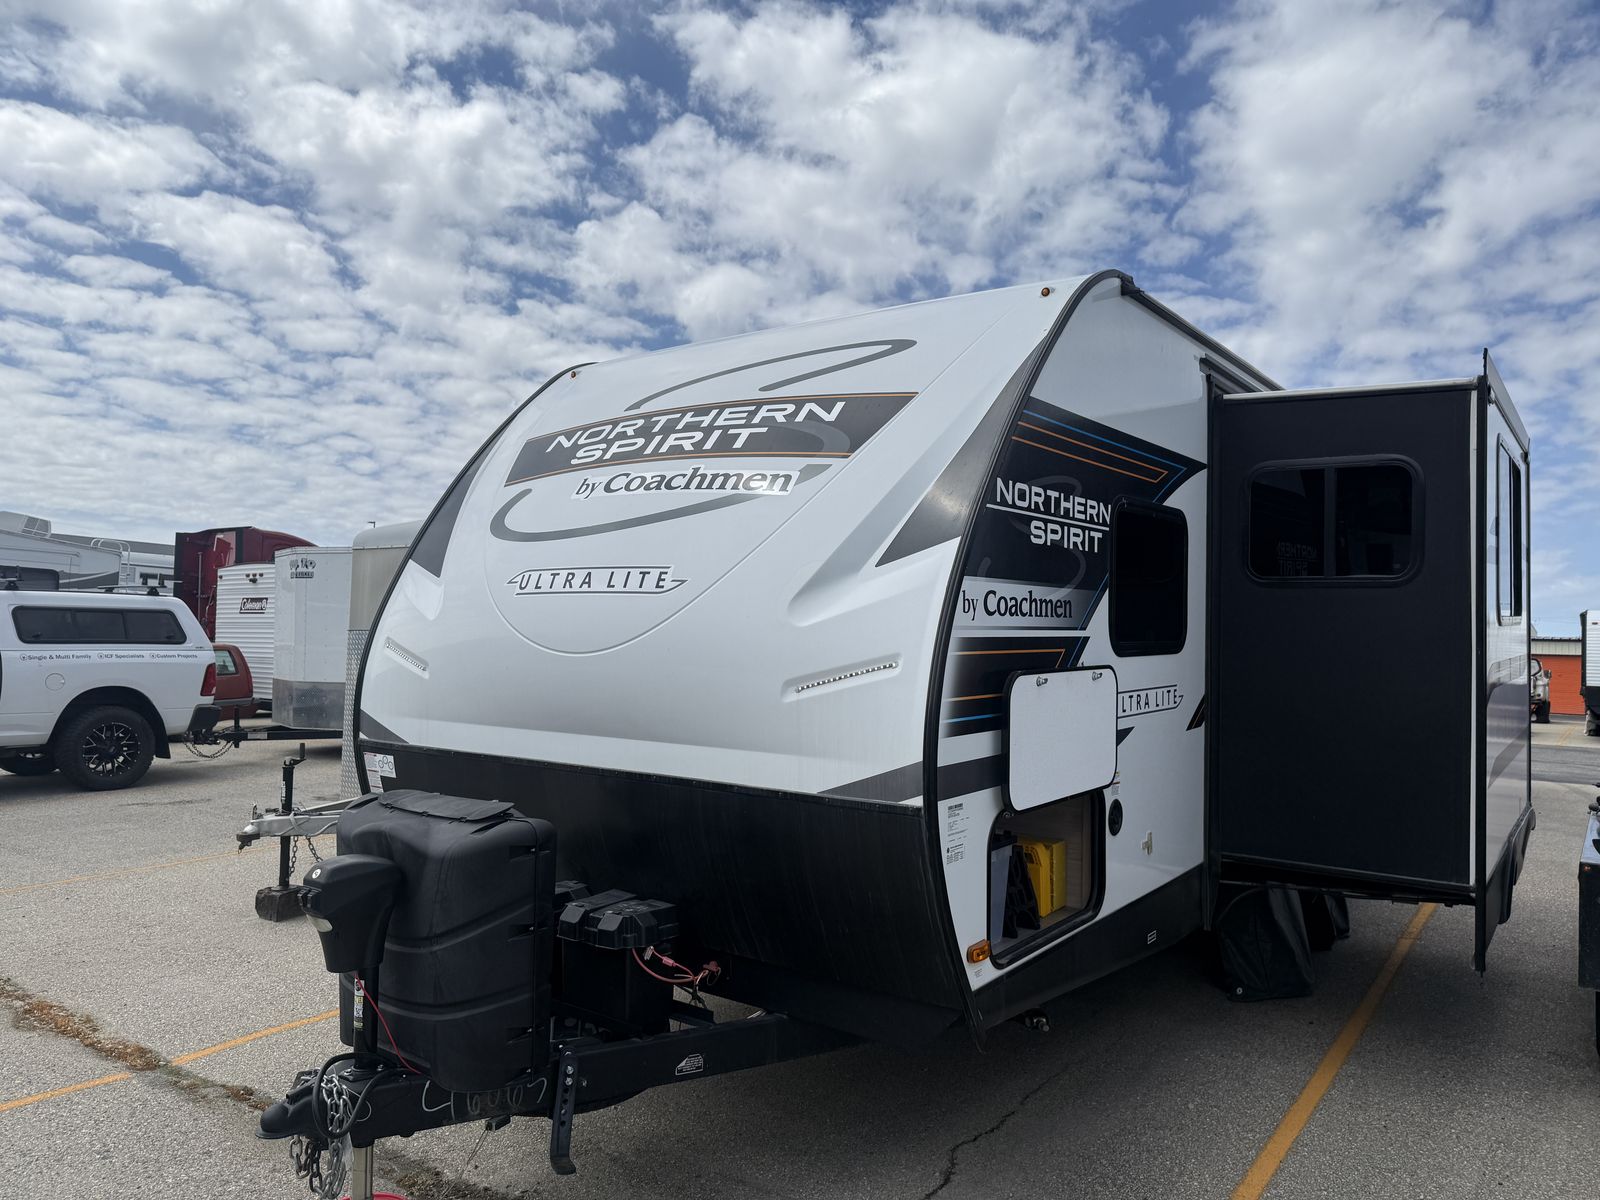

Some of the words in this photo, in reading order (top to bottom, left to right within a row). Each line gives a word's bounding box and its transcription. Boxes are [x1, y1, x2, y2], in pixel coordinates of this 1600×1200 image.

[545, 401, 847, 453] NORTHERN
[570, 427, 769, 465] SPIRIT
[574, 477, 602, 500] by
[603, 466, 793, 495] Coachmen
[996, 477, 1112, 525] NORTHERN
[1029, 520, 1104, 553] SPIRIT
[517, 571, 592, 591] ULTRA
[605, 570, 669, 589] LITE
[961, 590, 979, 621] by
[983, 590, 1073, 620] Coachmen
[27, 653, 47, 661] Single
[72, 653, 92, 661] Family
[1122, 692, 1151, 713] LTRA
[1155, 688, 1178, 708] LITE
